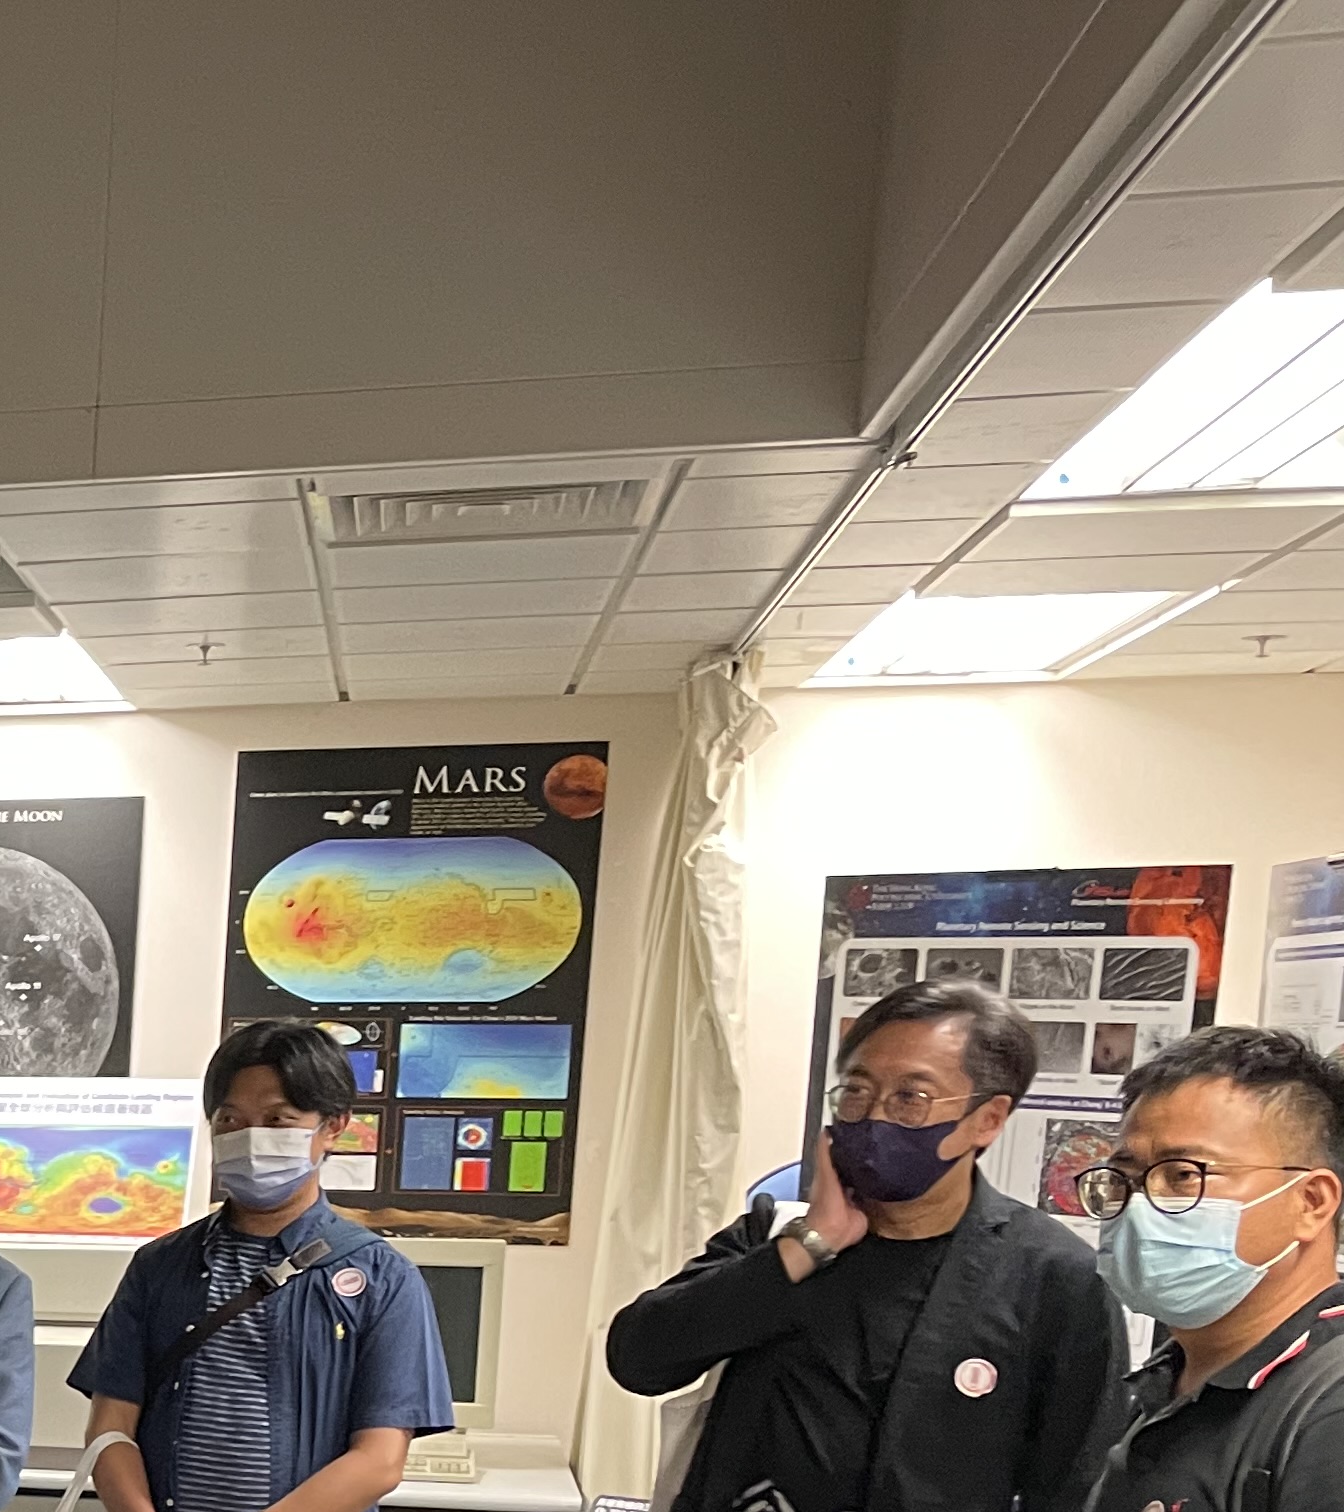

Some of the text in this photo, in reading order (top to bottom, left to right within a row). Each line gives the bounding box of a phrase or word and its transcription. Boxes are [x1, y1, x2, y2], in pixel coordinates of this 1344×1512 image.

[413, 765, 527, 795] MARS
[13, 809, 63, 823] MOON
[23, 933, 50, 943] Apollo
[4, 981, 31, 991] Apollo
